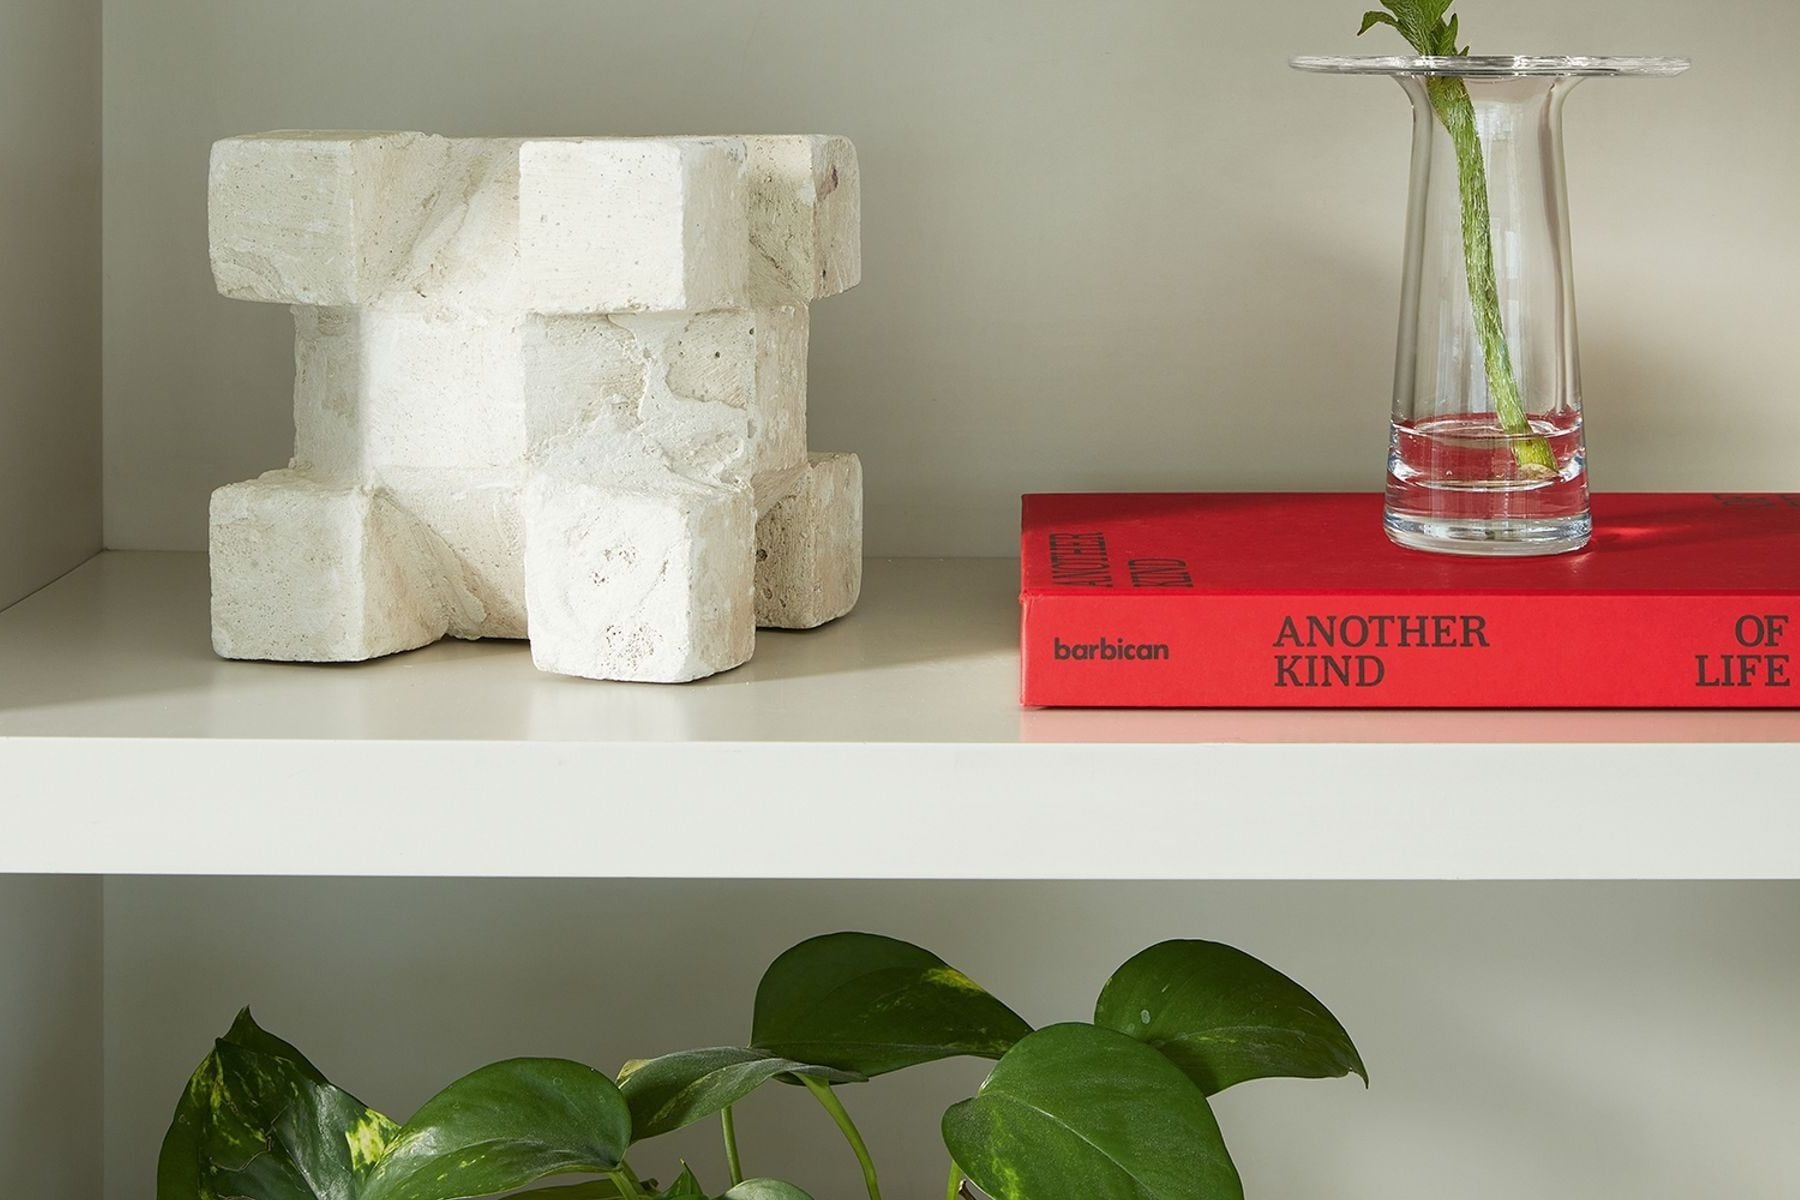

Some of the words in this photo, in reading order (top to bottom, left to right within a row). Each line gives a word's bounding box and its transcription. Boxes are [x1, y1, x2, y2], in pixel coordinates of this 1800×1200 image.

[1272, 614, 1490, 648] ANOTHER
[1734, 613, 1790, 648] OF
[1053, 636, 1170, 661] barbican
[1273, 654, 1386, 688] KIND
[1694, 653, 1792, 688] LIFE
